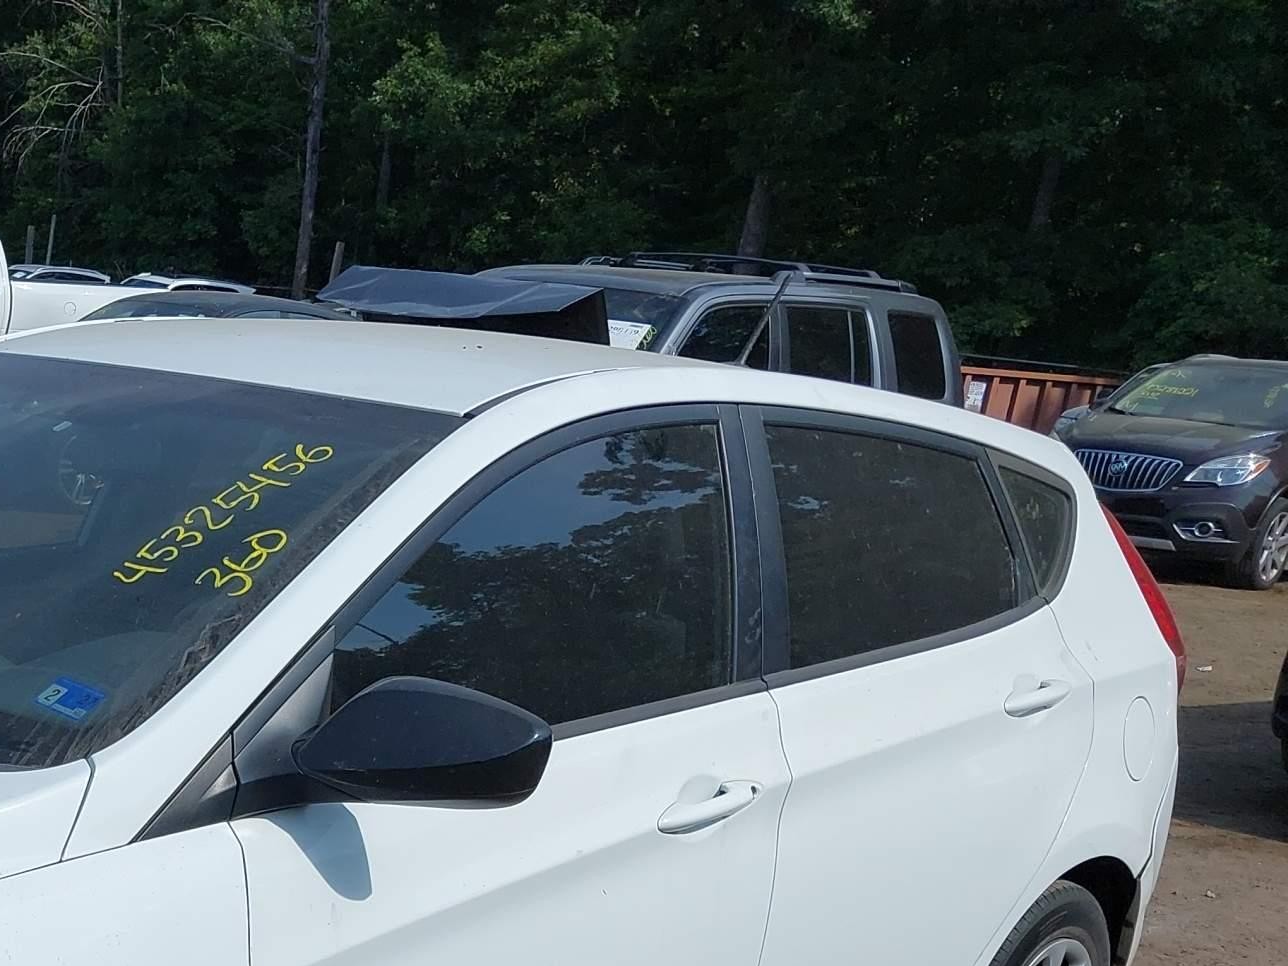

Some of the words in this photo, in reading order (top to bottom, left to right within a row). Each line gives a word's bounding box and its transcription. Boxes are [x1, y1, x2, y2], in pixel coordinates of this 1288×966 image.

[113, 444, 334, 584] 45325456
[194, 528, 288, 597] 360
[43, 688, 62, 702] 2
